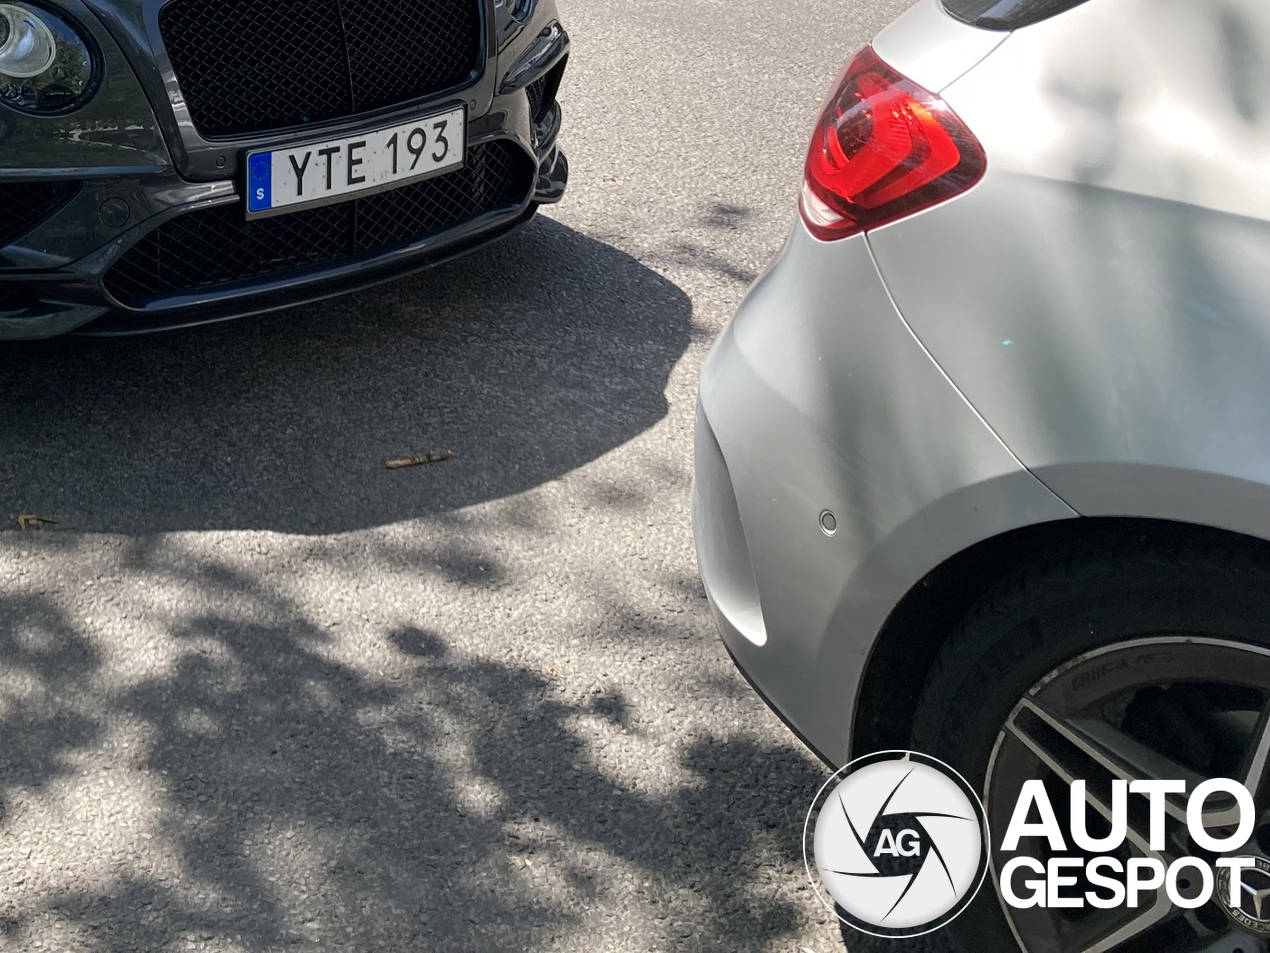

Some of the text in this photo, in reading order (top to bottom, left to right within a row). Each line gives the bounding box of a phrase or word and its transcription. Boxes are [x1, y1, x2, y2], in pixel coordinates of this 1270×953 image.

[288, 120, 448, 196] YTE 193
[256, 187, 265, 200] S
